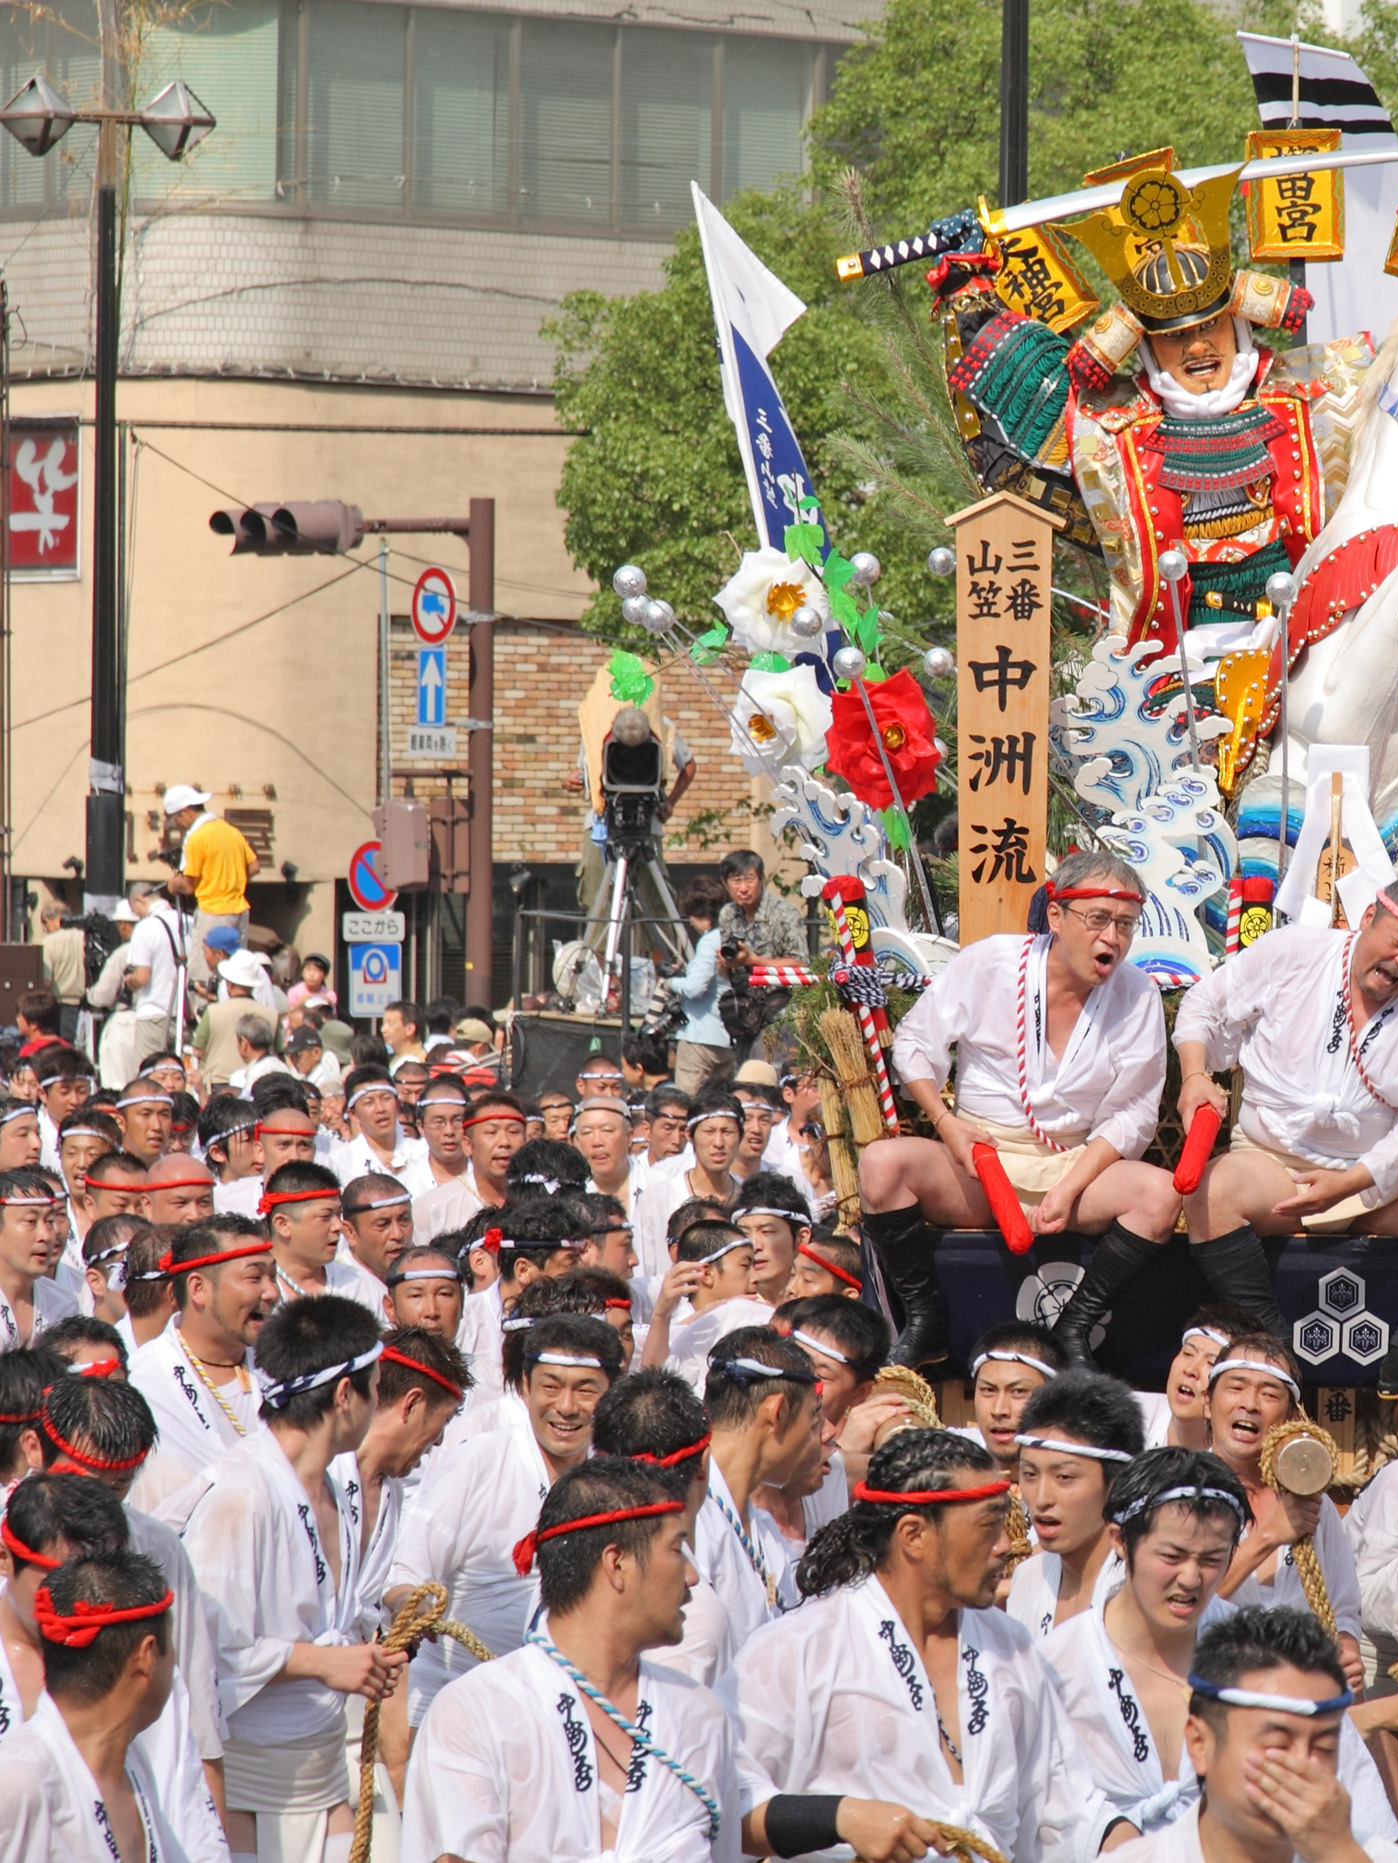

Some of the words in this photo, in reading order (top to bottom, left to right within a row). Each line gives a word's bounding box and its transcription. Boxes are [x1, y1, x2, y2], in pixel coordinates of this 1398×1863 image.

[966, 540, 1002, 620] 山笠
[1003, 539, 1044, 621] 三番
[967, 645, 1038, 885] 中洲流
[349, 920, 399, 935] ここから
